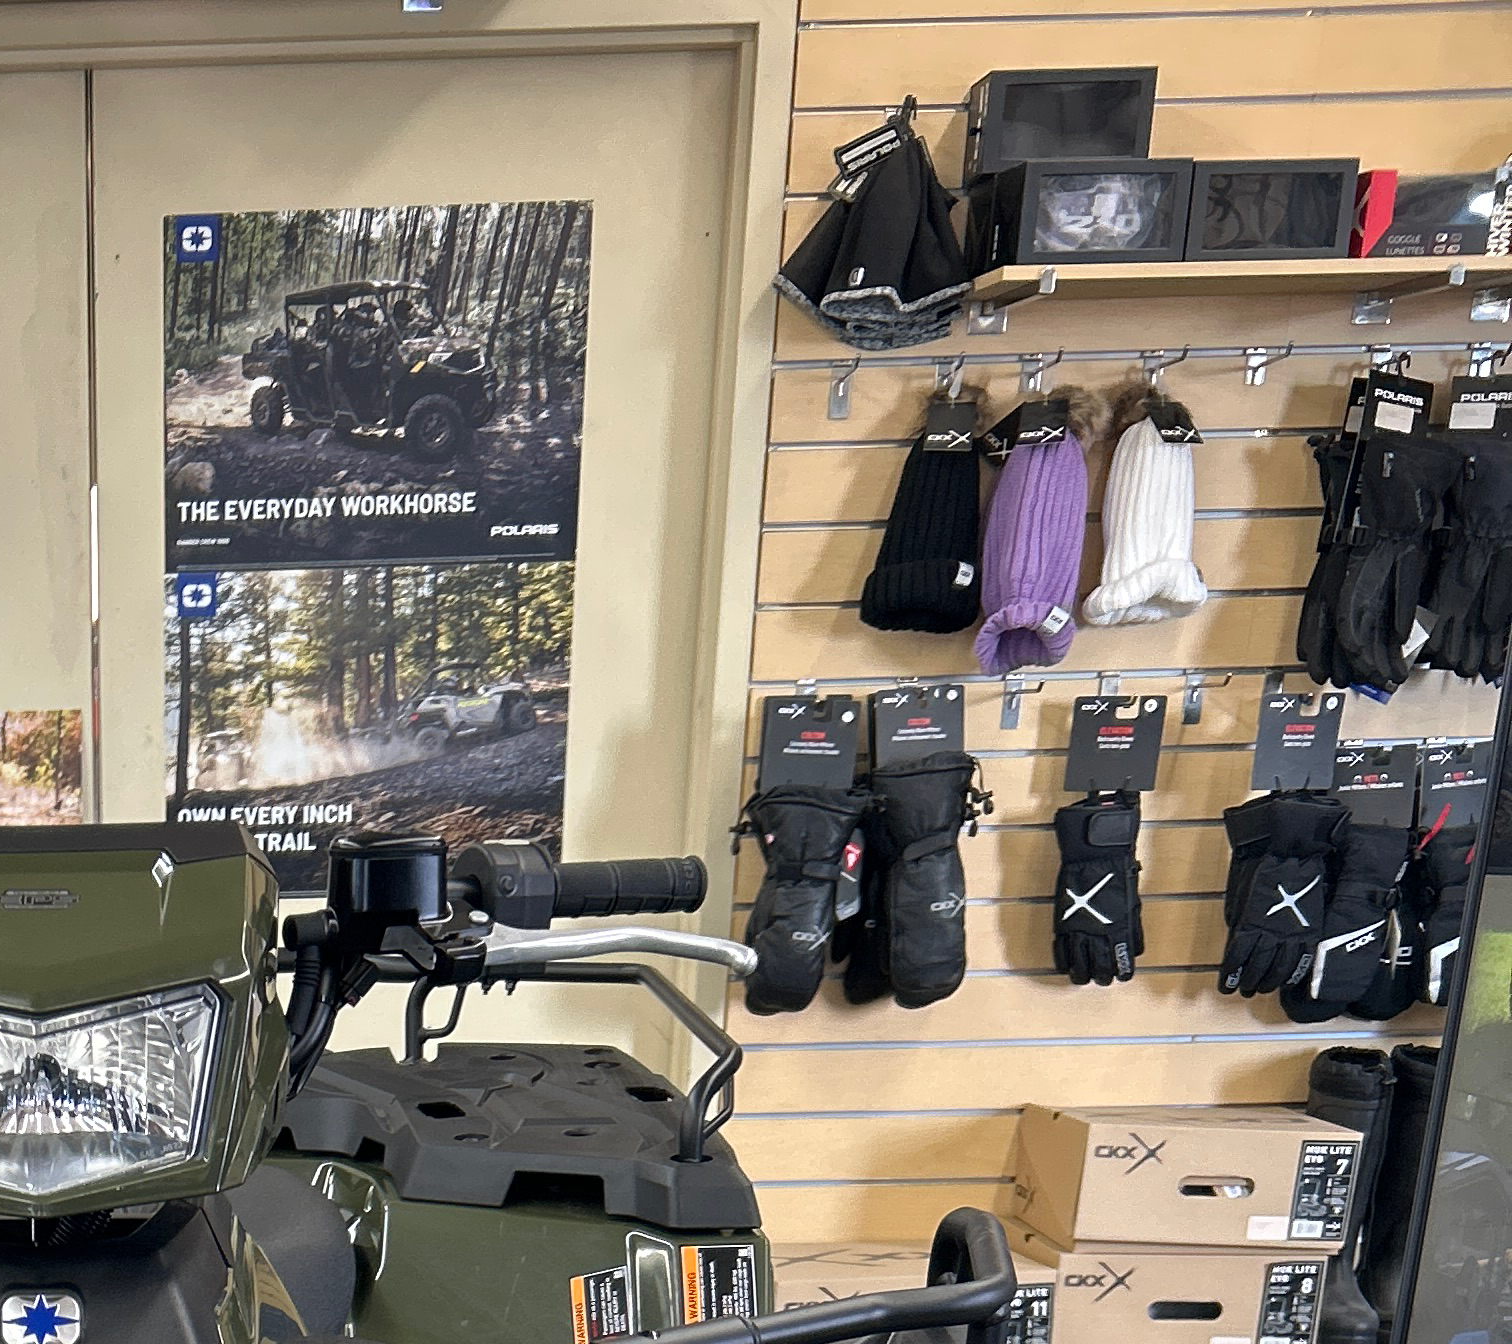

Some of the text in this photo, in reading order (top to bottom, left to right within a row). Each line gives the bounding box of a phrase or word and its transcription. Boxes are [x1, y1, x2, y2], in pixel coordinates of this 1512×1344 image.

[1374, 387, 1424, 407] POLARIS
[176, 491, 477, 523] THE EVERYDAY WORKHORSE
[490, 523, 559, 537] POLARIS
[177, 803, 353, 825] OWN EVERY INCH
[253, 831, 317, 852] TRAIL
[1336, 1158, 1349, 1175] 7
[1301, 1277, 1314, 1294] 8
[687, 1272, 699, 1320] WARNING
[1030, 1300, 1048, 1317] 11
